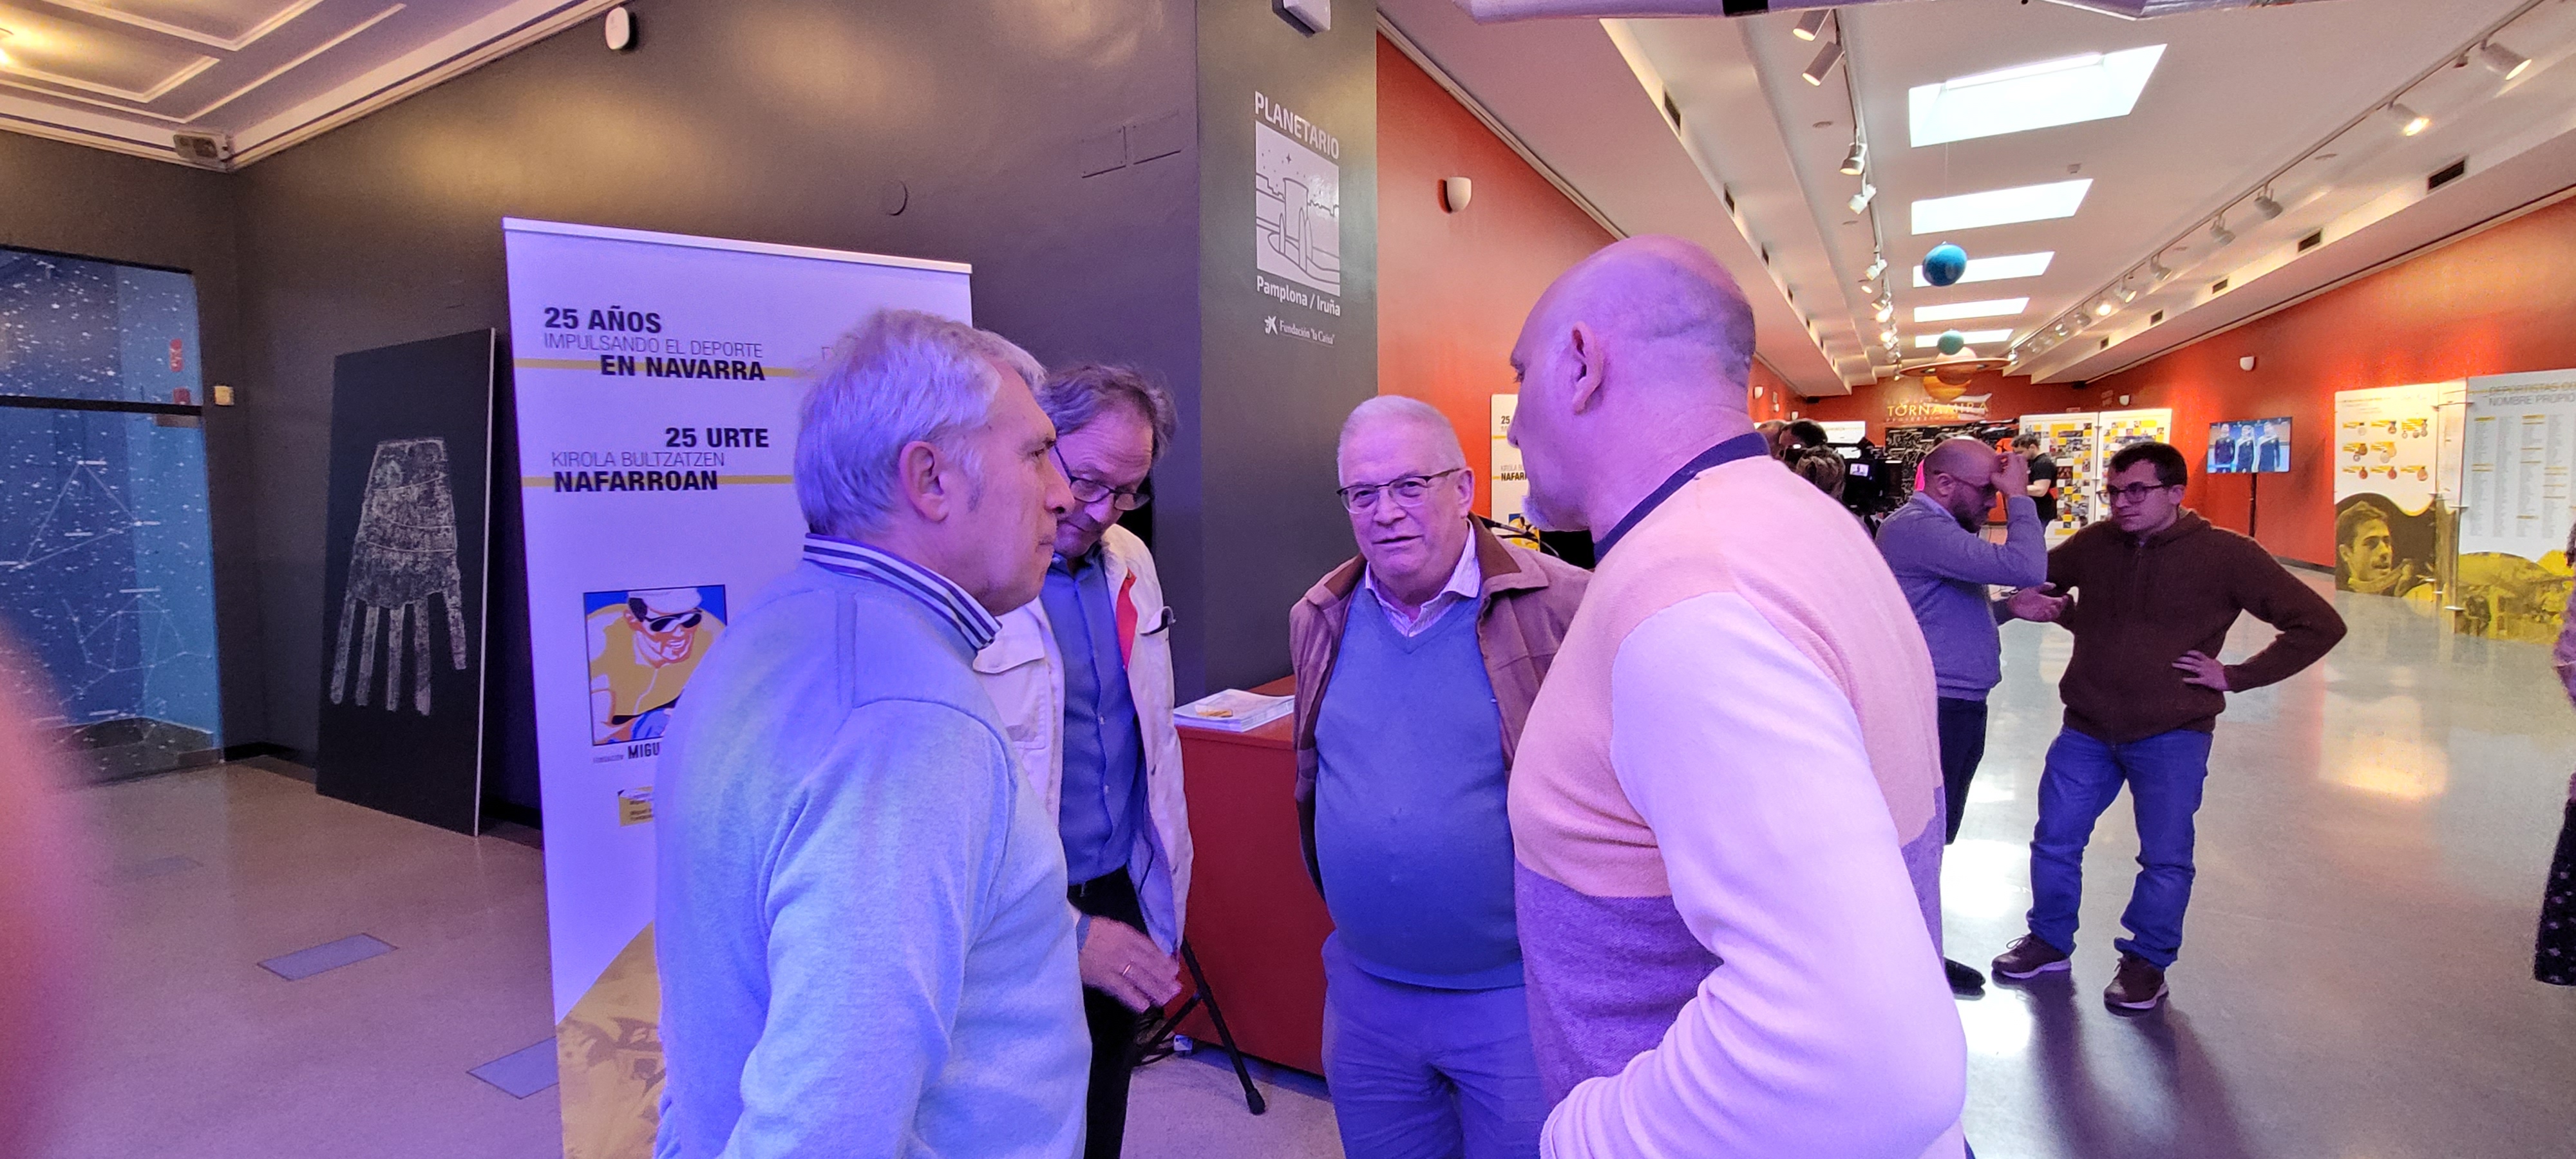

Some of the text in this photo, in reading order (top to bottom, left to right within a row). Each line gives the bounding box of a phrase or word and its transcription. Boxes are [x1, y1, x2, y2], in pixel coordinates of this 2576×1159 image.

[1255, 90, 1340, 160] PLANETARIO
[1256, 275, 1308, 306] Pamplona
[1317, 295, 1341, 317] Iruña
[544, 305, 661, 334] 25 AÑOS
[1280, 320, 1310, 339] Fundación
[544, 333, 762, 357] IMPULSANDO EL DEPORTE
[600, 354, 766, 381] EN NAVARRA
[1501, 416, 1510, 424] 25
[665, 428, 769, 448] 25 URTE
[551, 451, 724, 467] KIROLA BULTZATZEN
[554, 470, 718, 493] NAFARROAN
[628, 742, 660, 759] MIGU
